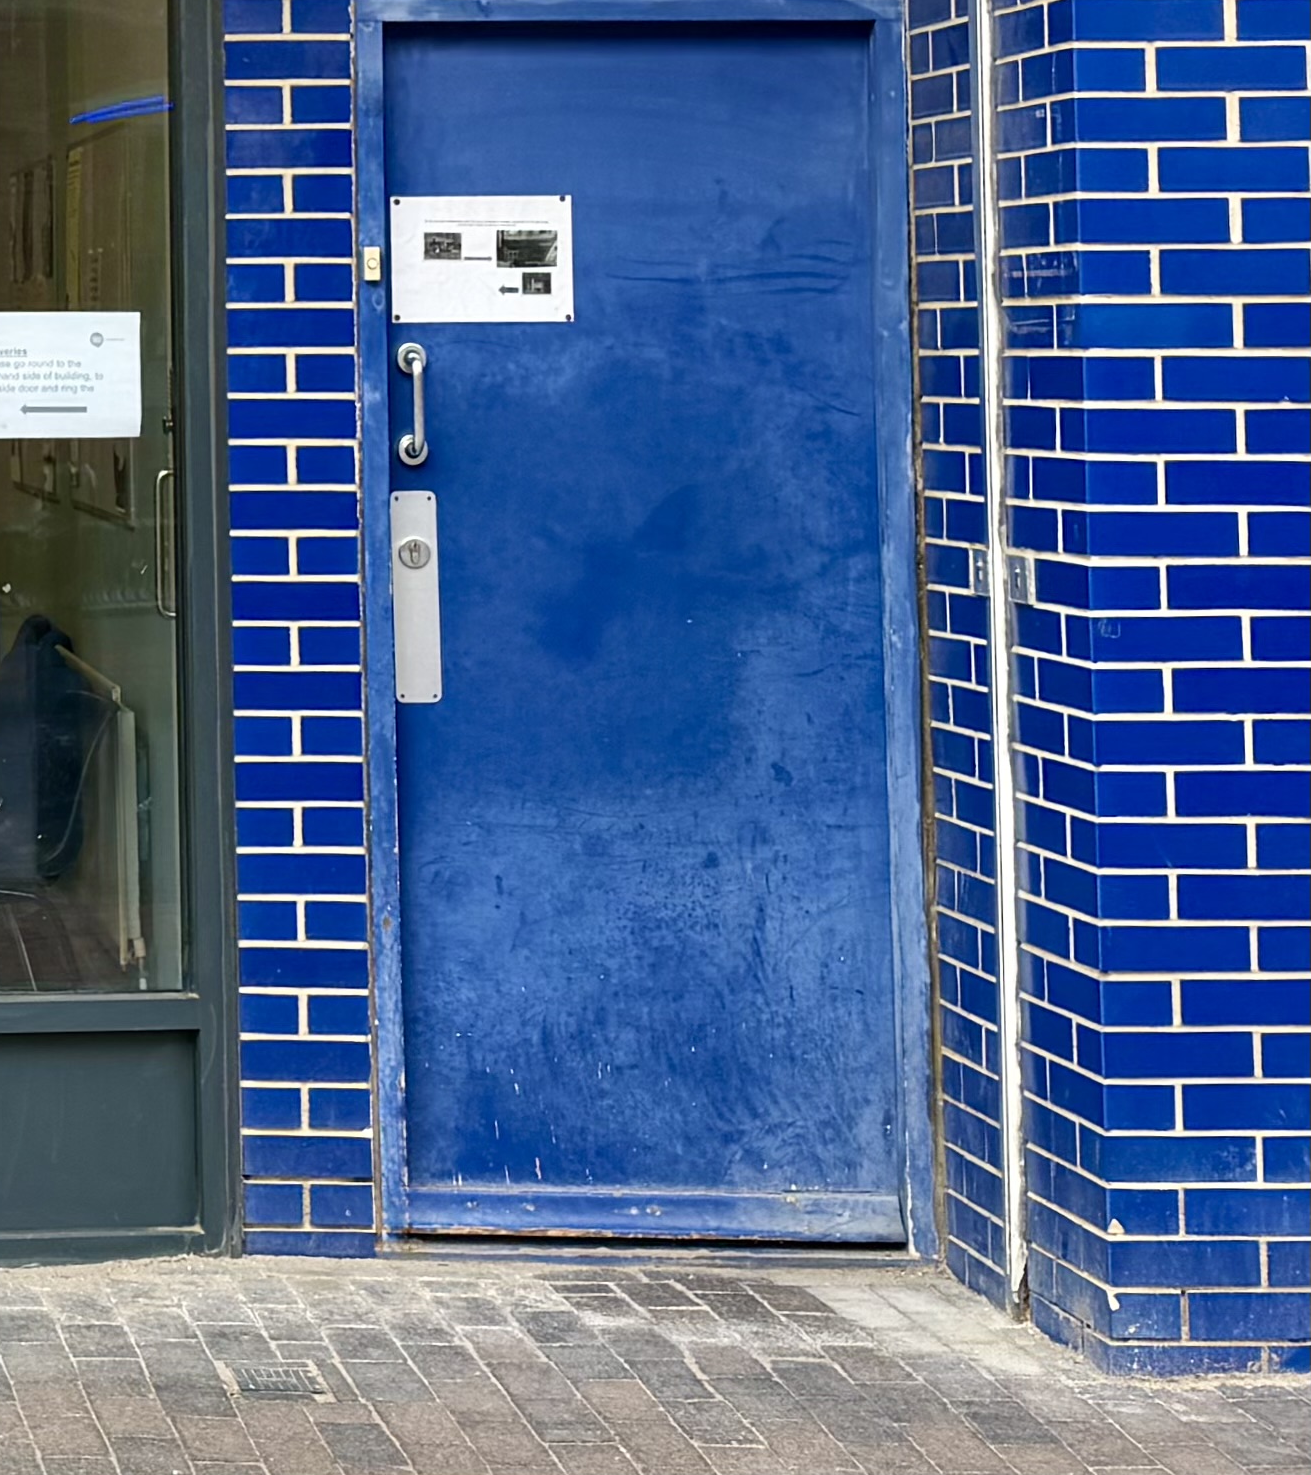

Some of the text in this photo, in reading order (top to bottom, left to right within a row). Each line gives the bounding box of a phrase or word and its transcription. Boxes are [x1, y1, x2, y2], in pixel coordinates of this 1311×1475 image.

[14, 360, 25, 369] go
[28, 359, 53, 368] round
[56, 359, 65, 368] to
[68, 359, 81, 368] the
[23, 371, 41, 380] side
[43, 371, 53, 380] of
[95, 371, 104, 380] to
[18, 384, 39, 393] door
[41, 384, 58, 393] and
[61, 384, 78, 394] ring
[80, 384, 94, 393] the
